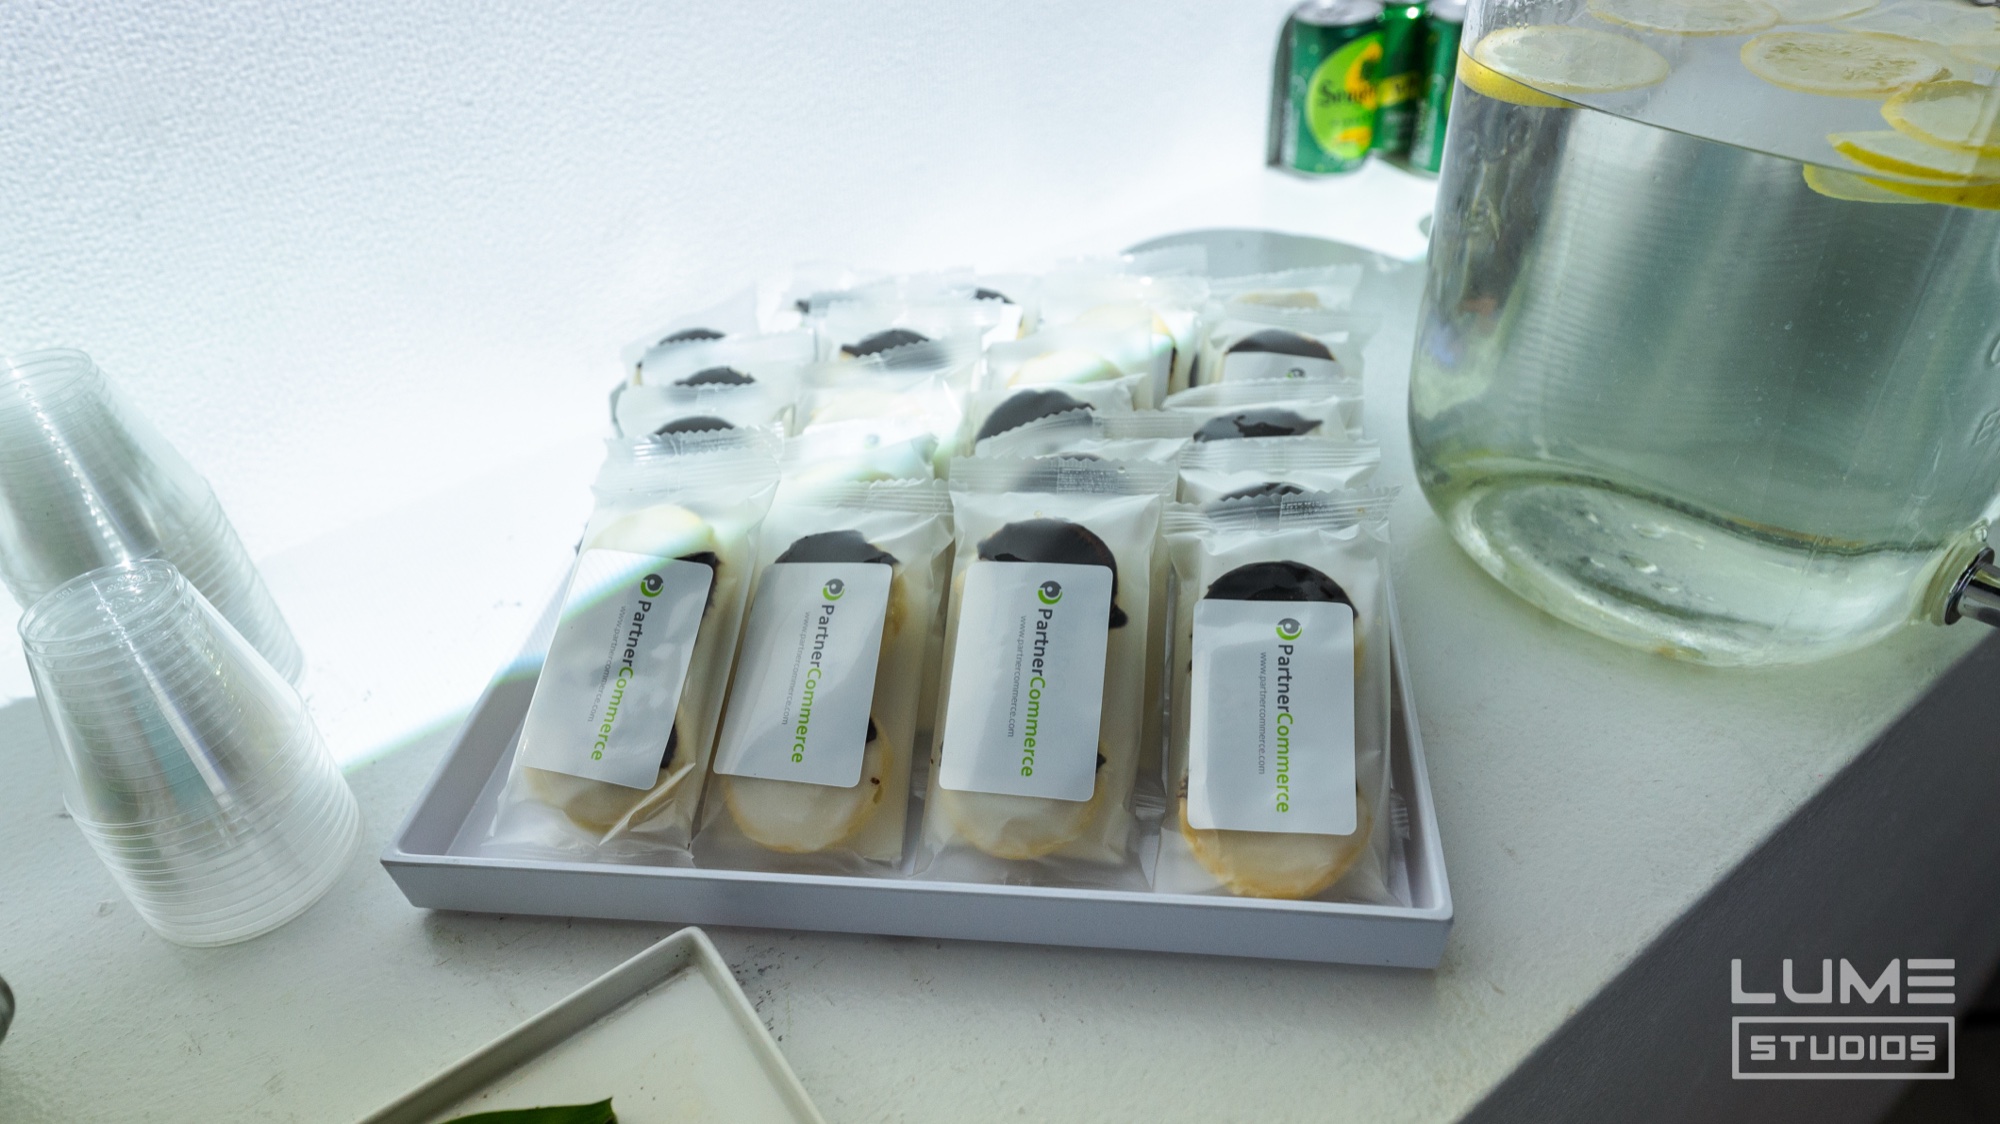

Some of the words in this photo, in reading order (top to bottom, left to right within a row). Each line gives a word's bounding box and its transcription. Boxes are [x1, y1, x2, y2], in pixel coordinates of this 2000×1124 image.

[587, 605, 628, 722] www.partnercommerce.com
[590, 600, 653, 762] PartnerCommerce
[781, 611, 811, 725] www.partnercommerce.com
[790, 604, 836, 763] PartnerCommerce
[1007, 615, 1029, 738] www.partnercommerce.com
[1020, 607, 1054, 778] PartnerCommerce
[1259, 651, 1267, 775] www.partnercommerce.com
[1275, 644, 1295, 814] PartnerCommerce
